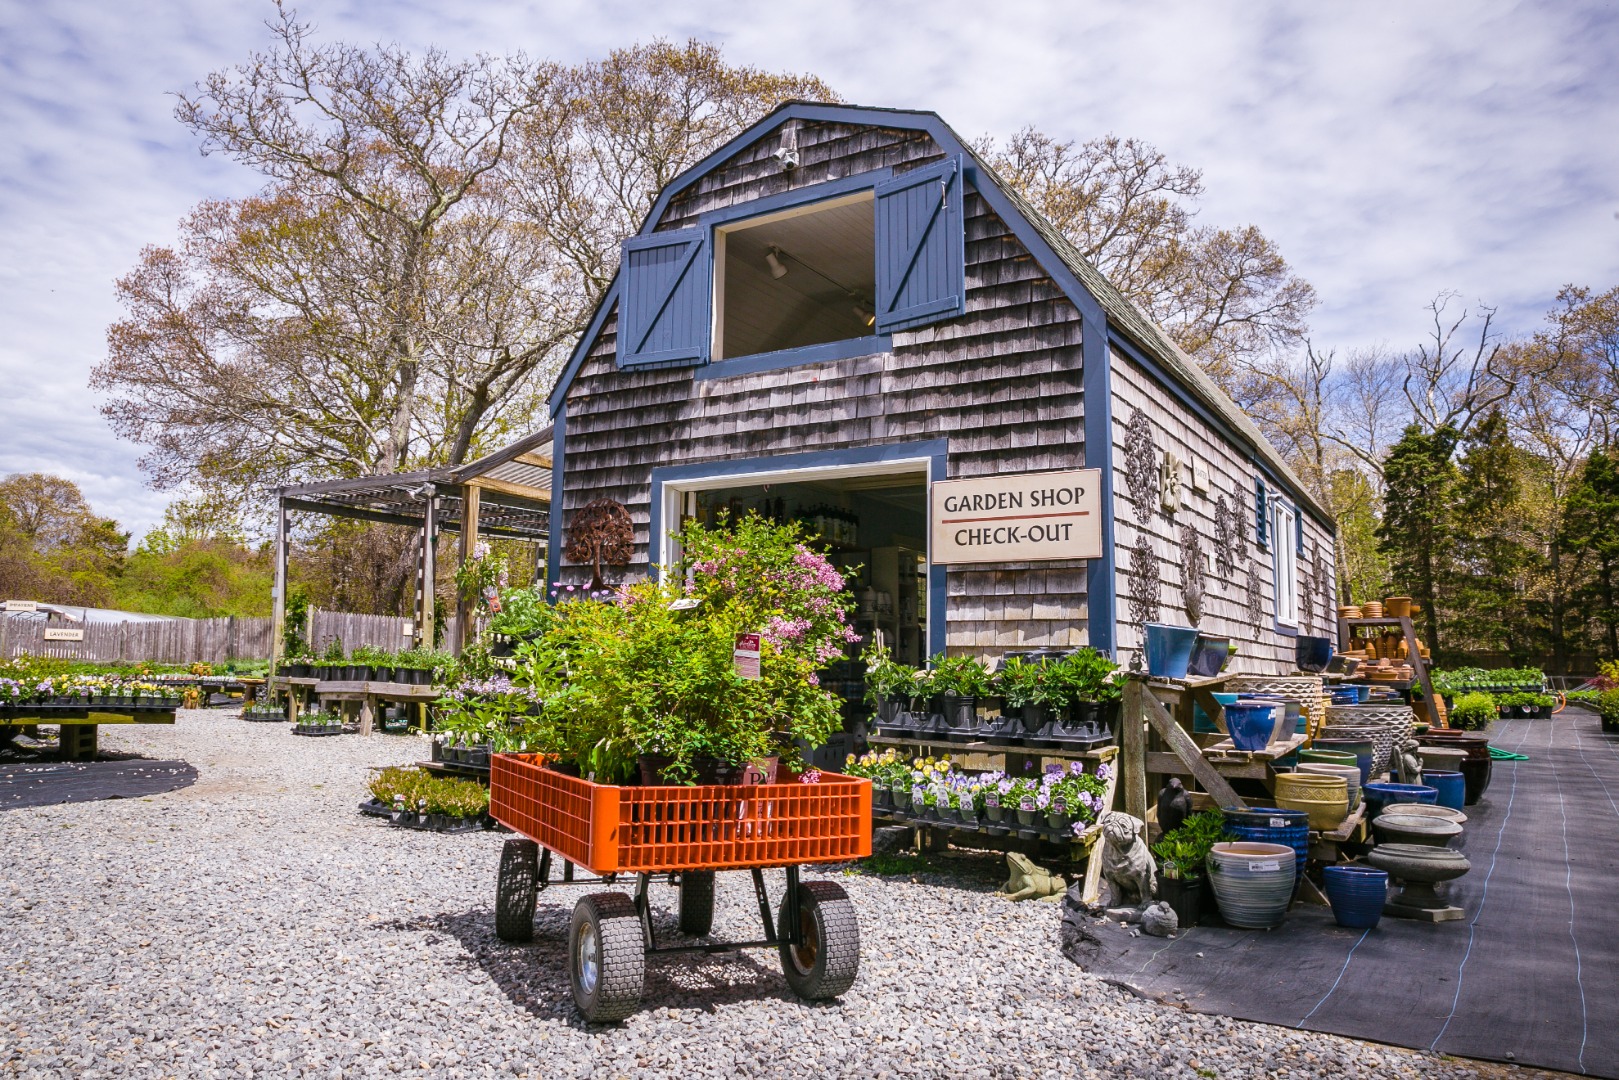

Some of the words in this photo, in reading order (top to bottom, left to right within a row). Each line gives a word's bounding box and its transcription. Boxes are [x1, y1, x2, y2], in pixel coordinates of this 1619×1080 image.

[944, 491, 1023, 512] GARDEN
[1030, 487, 1085, 507] SHOP
[954, 523, 1073, 546] CHECK-OUT
